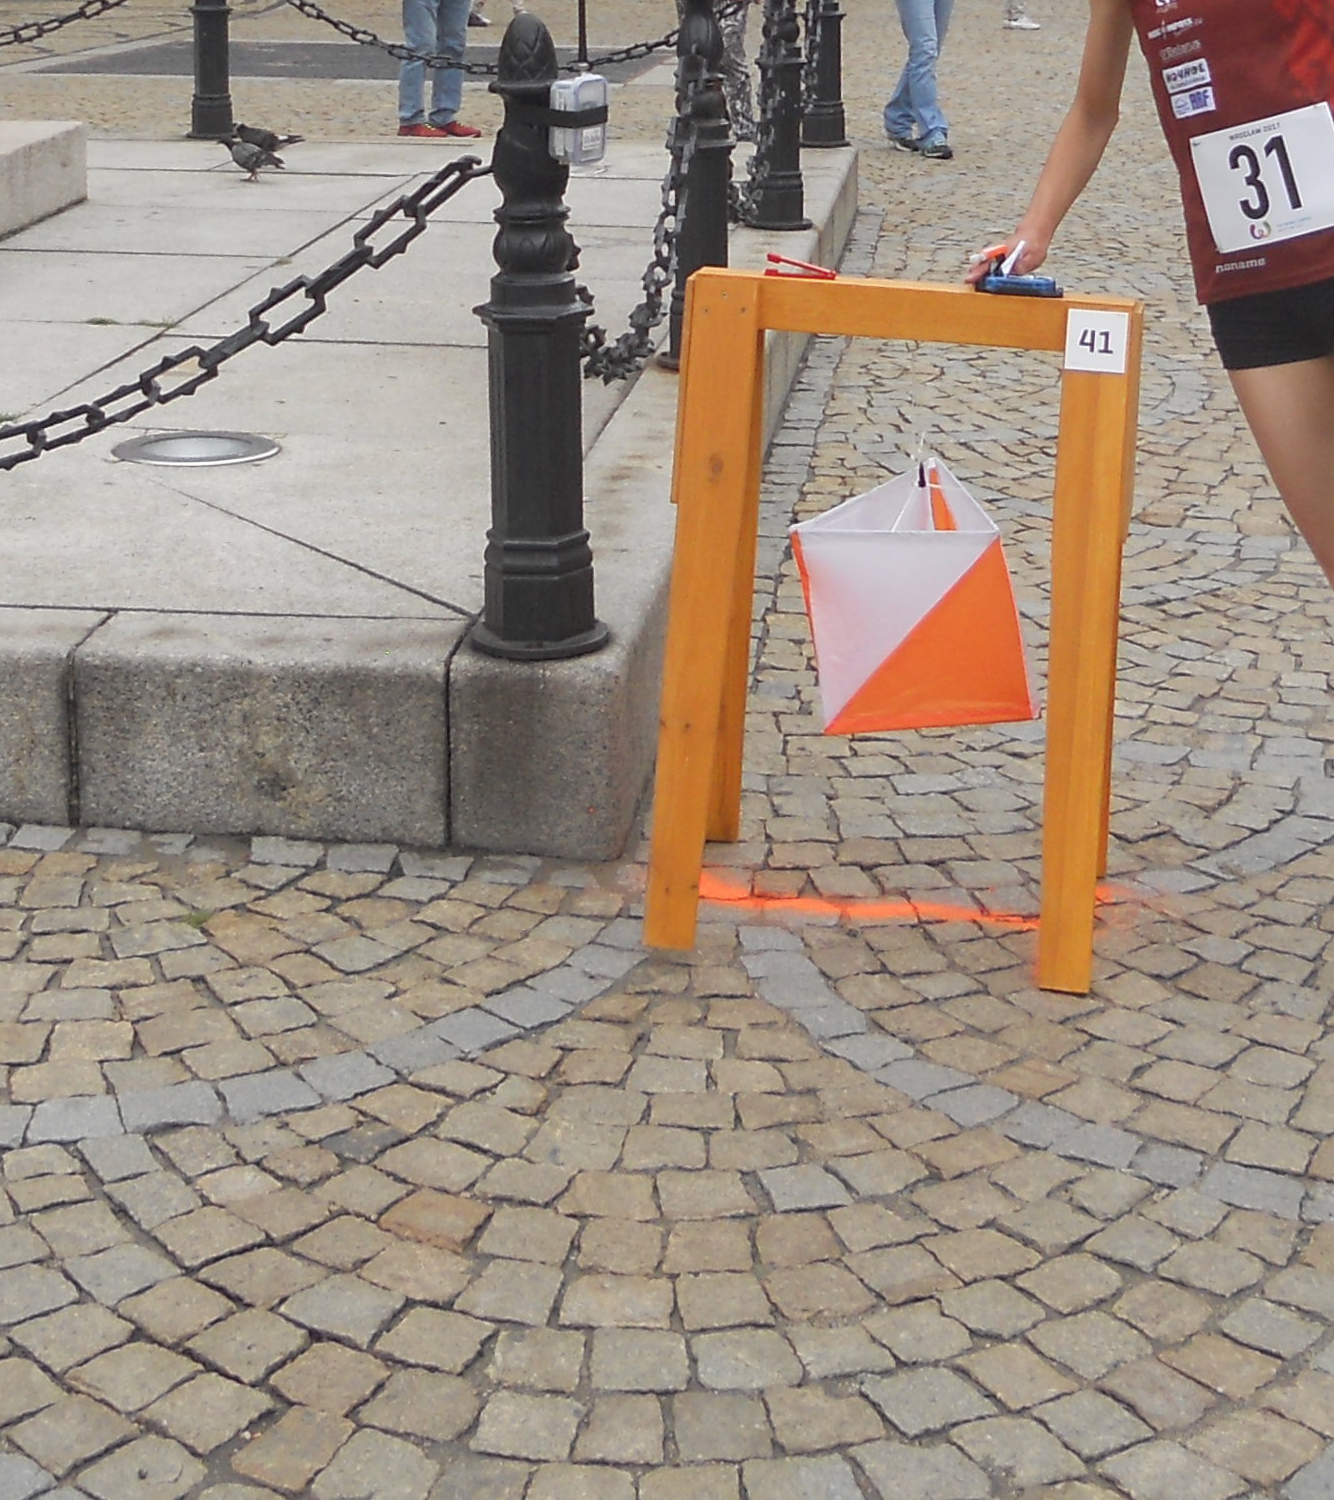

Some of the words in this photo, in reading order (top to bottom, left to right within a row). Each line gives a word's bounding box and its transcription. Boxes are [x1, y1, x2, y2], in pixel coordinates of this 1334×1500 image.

[1229, 134, 1303, 220] 31
[1215, 258, 1266, 273] noname
[1078, 328, 1114, 354] 41
